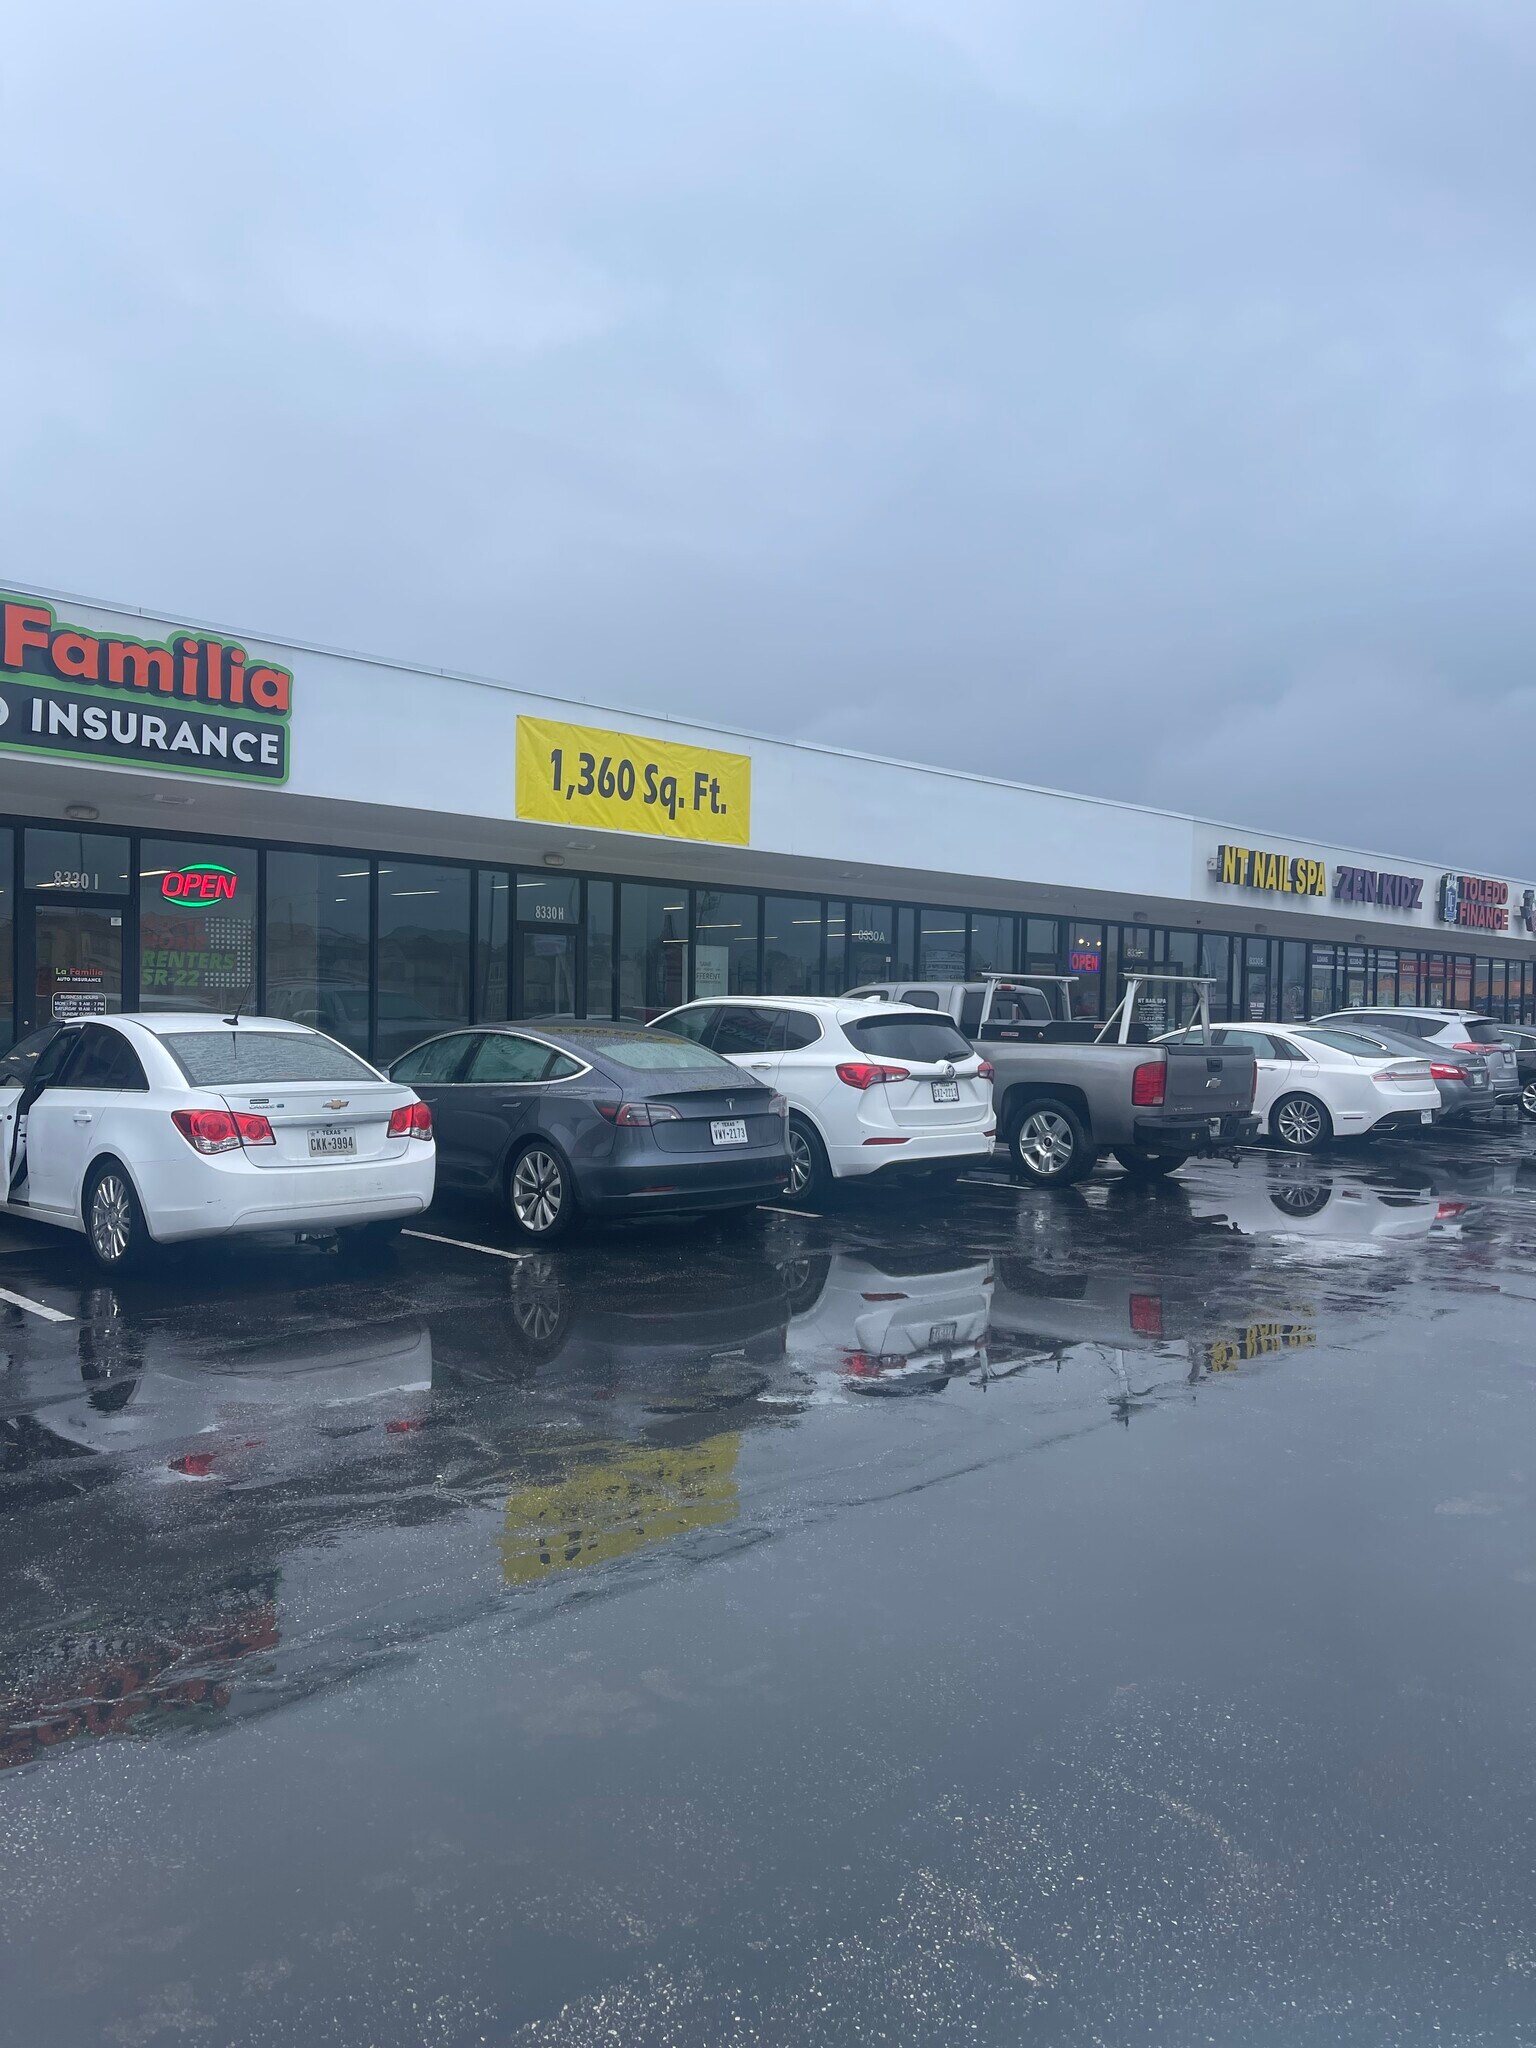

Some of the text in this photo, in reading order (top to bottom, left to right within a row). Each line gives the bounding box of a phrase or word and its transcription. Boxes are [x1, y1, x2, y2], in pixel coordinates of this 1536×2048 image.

[4, 602, 291, 710] Familia
[31, 697, 279, 766] INSURANCE
[550, 748, 727, 820] 1,360 Sq. Ft.
[54, 870, 89, 889] 8330
[1220, 845, 1250, 885] NT
[1252, 851, 1293, 892] NAIL
[1295, 858, 1327, 896] SPA
[161, 872, 238, 899] OPEN
[1335, 866, 1424, 909] ZEN KIDZ
[1461, 876, 1509, 905] TOLEDO
[1459, 902, 1509, 931] FINANCE
[55, 967, 104, 976] La Familia
[141, 950, 237, 969] RENTERS
[1071, 953, 1099, 971] OPEN
[141, 968, 200, 987] SR-22
